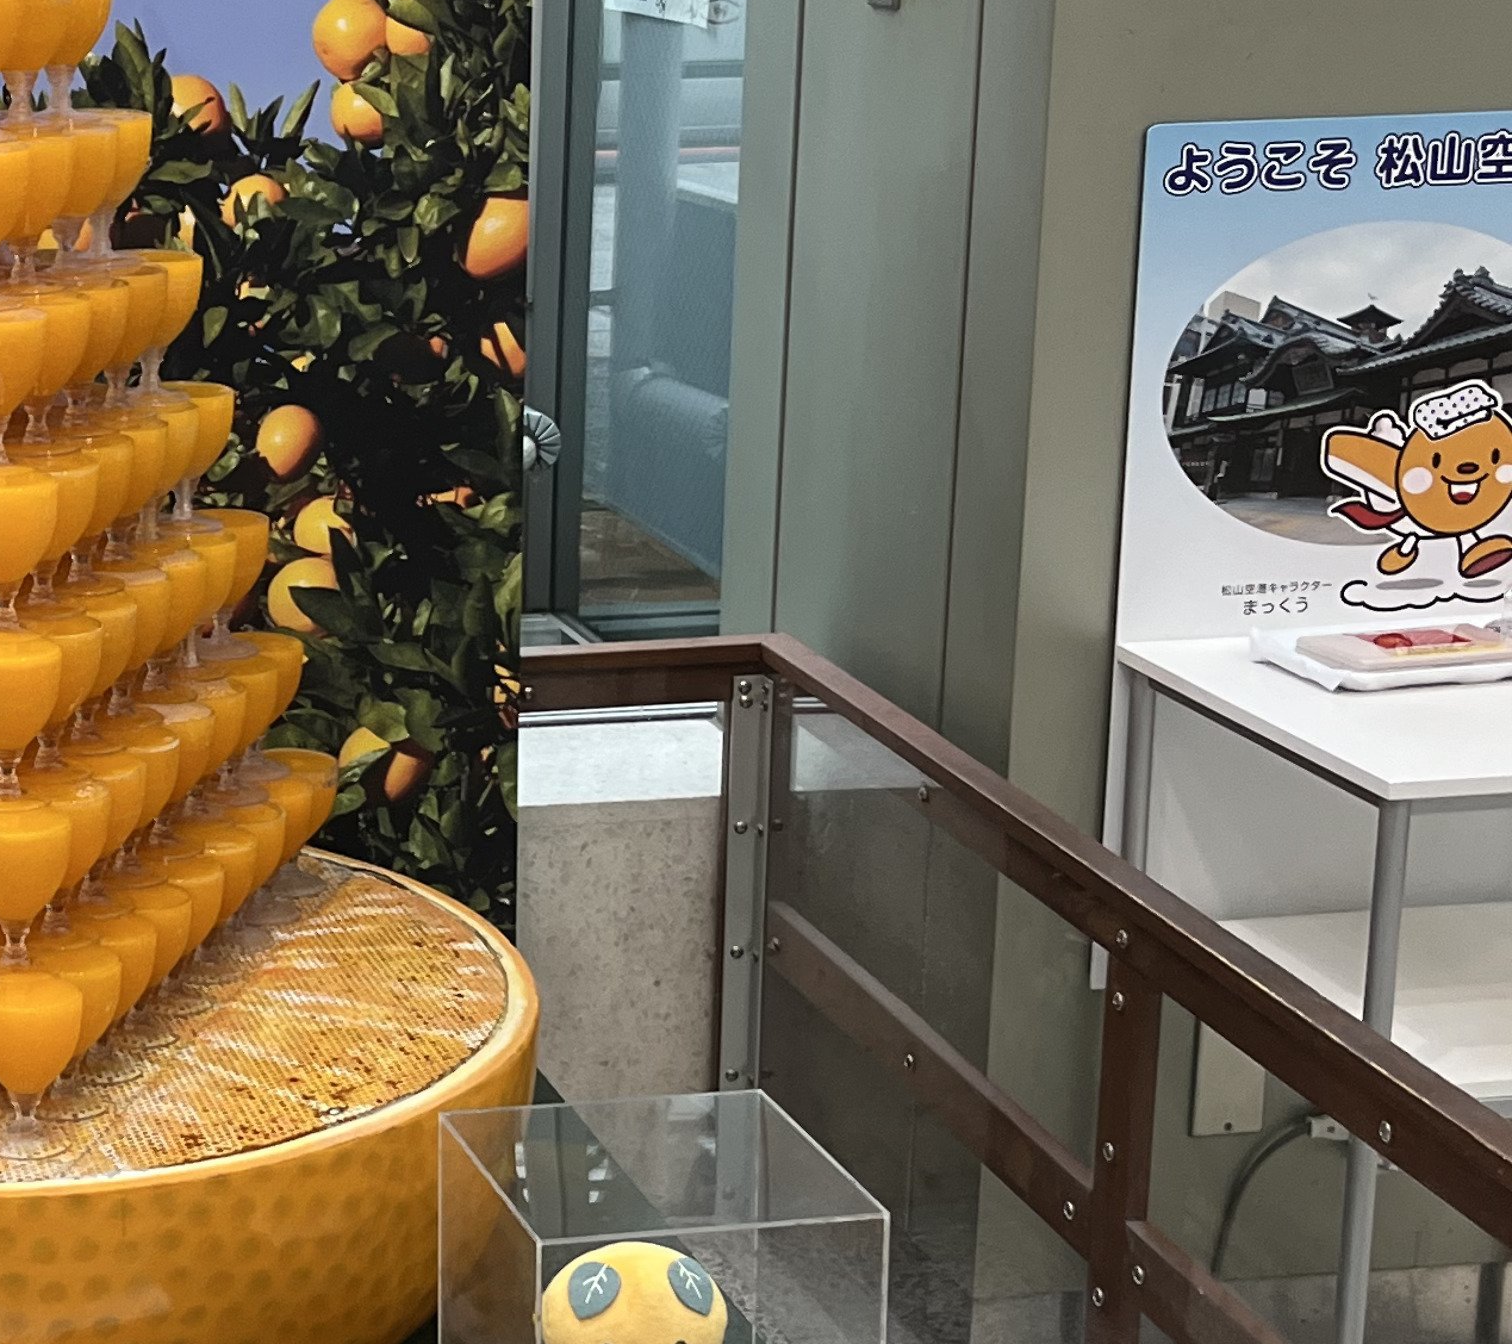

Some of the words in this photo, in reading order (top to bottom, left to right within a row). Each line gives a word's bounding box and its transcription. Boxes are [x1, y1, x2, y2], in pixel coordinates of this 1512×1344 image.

[1163, 138, 1357, 196] ようこそ
[1375, 129, 1512, 189] 松山空
[1243, 597, 1308, 615] まっくう
